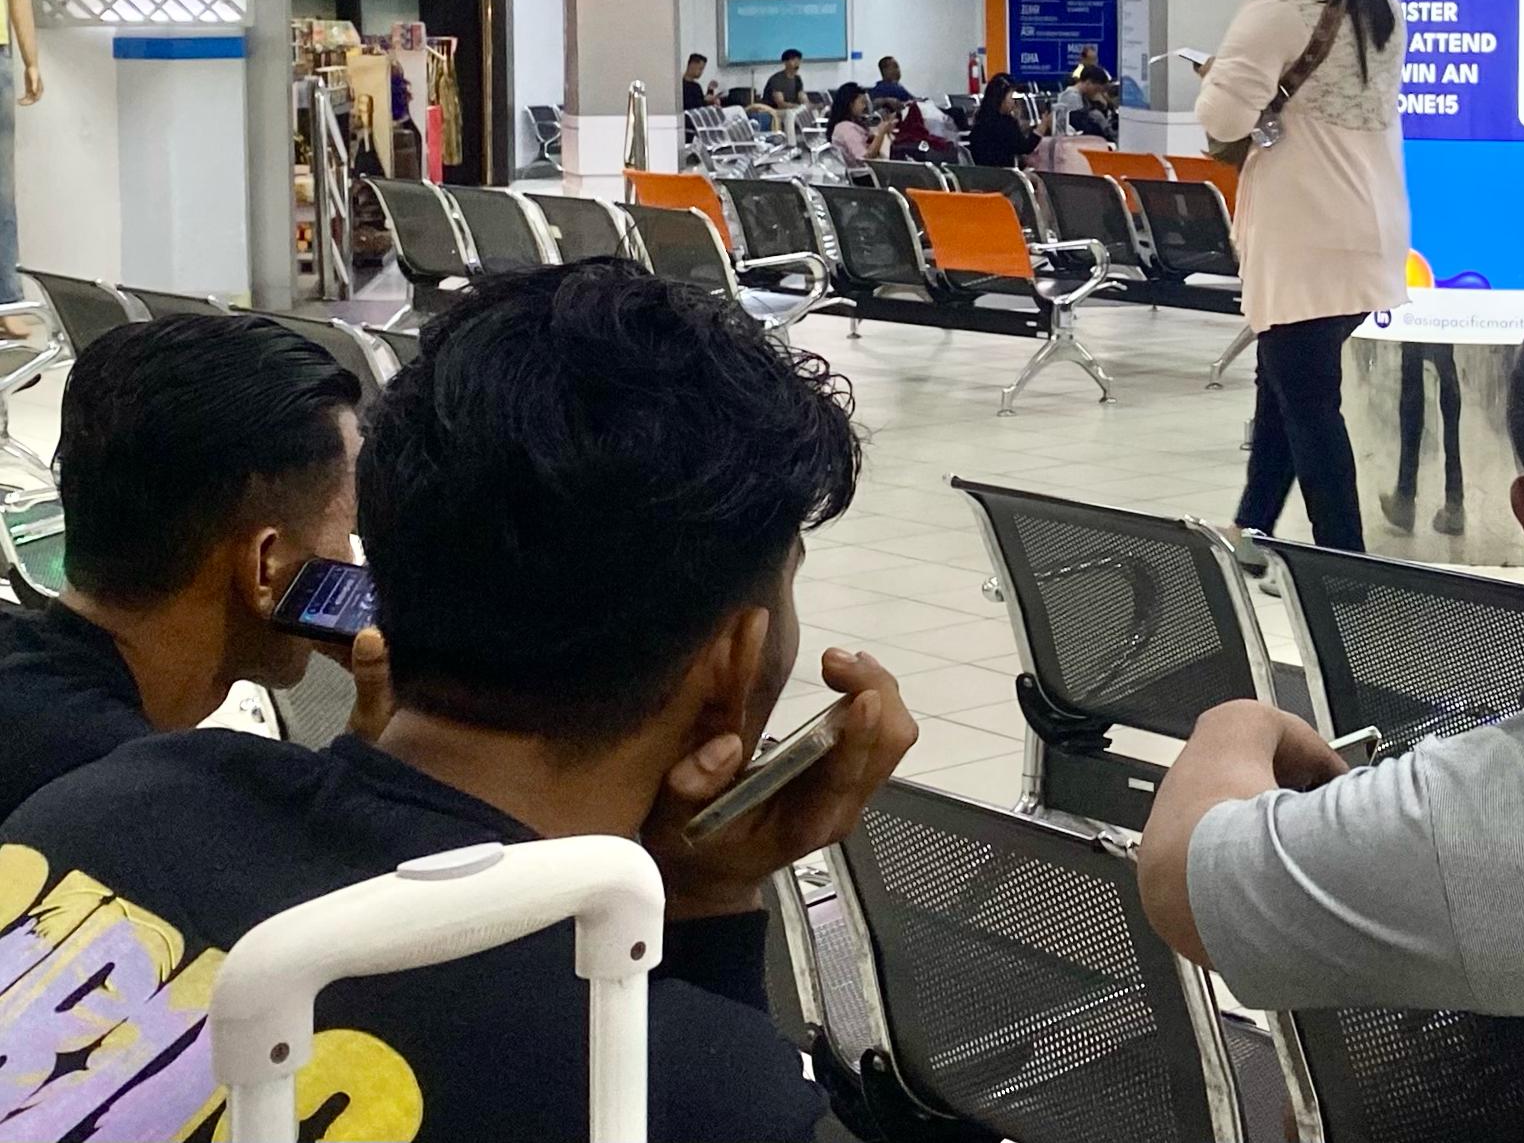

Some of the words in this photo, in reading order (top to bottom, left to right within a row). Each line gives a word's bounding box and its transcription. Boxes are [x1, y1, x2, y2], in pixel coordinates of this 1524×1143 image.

[1400, 1, 1459, 23] ISTER
[1408, 31, 1498, 53] ATTEND
[1441, 62, 1480, 85] AN
